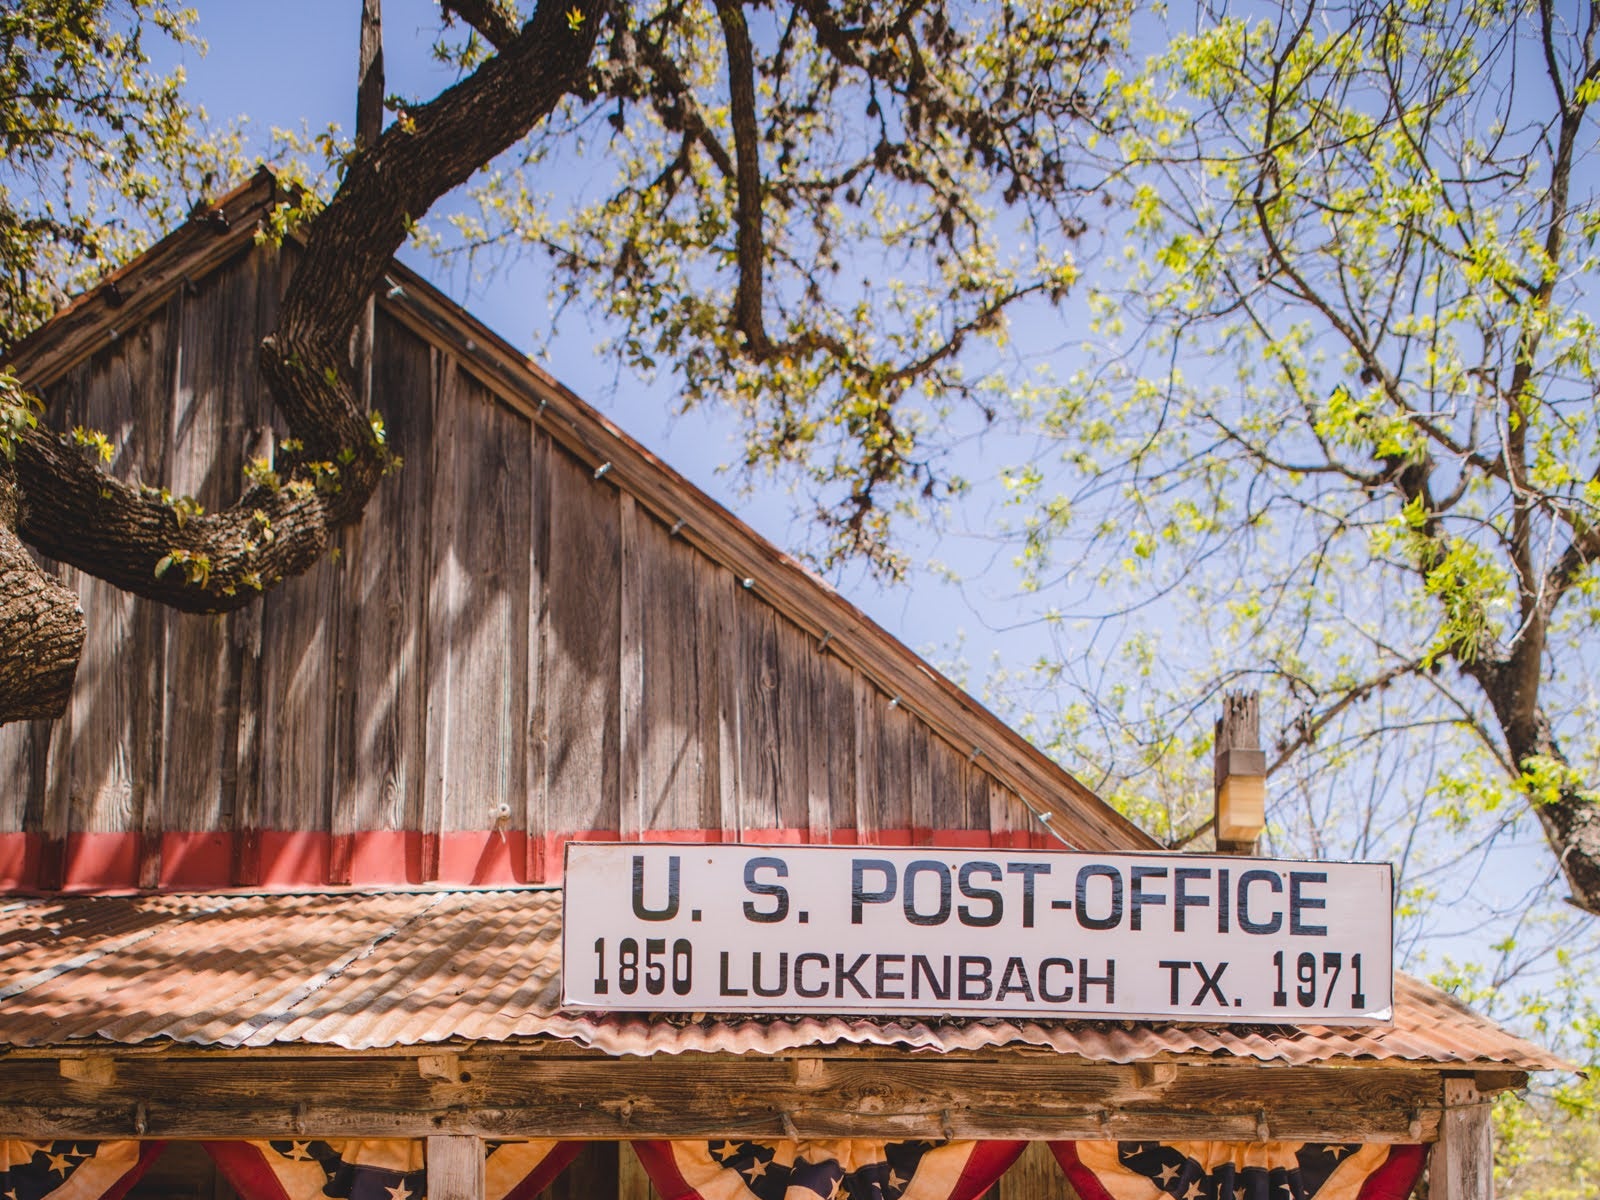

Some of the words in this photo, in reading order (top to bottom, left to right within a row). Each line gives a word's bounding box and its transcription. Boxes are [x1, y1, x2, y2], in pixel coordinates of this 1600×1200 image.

[632, 855, 702, 922] U.
[742, 856, 809, 924] S.
[851, 858, 1328, 937] POST-OFFICE
[593, 937, 693, 996] 1850
[719, 950, 1116, 1005] LUCKENBACH
[1158, 960, 1243, 1008] TX.
[1273, 950, 1366, 1010] 1971
